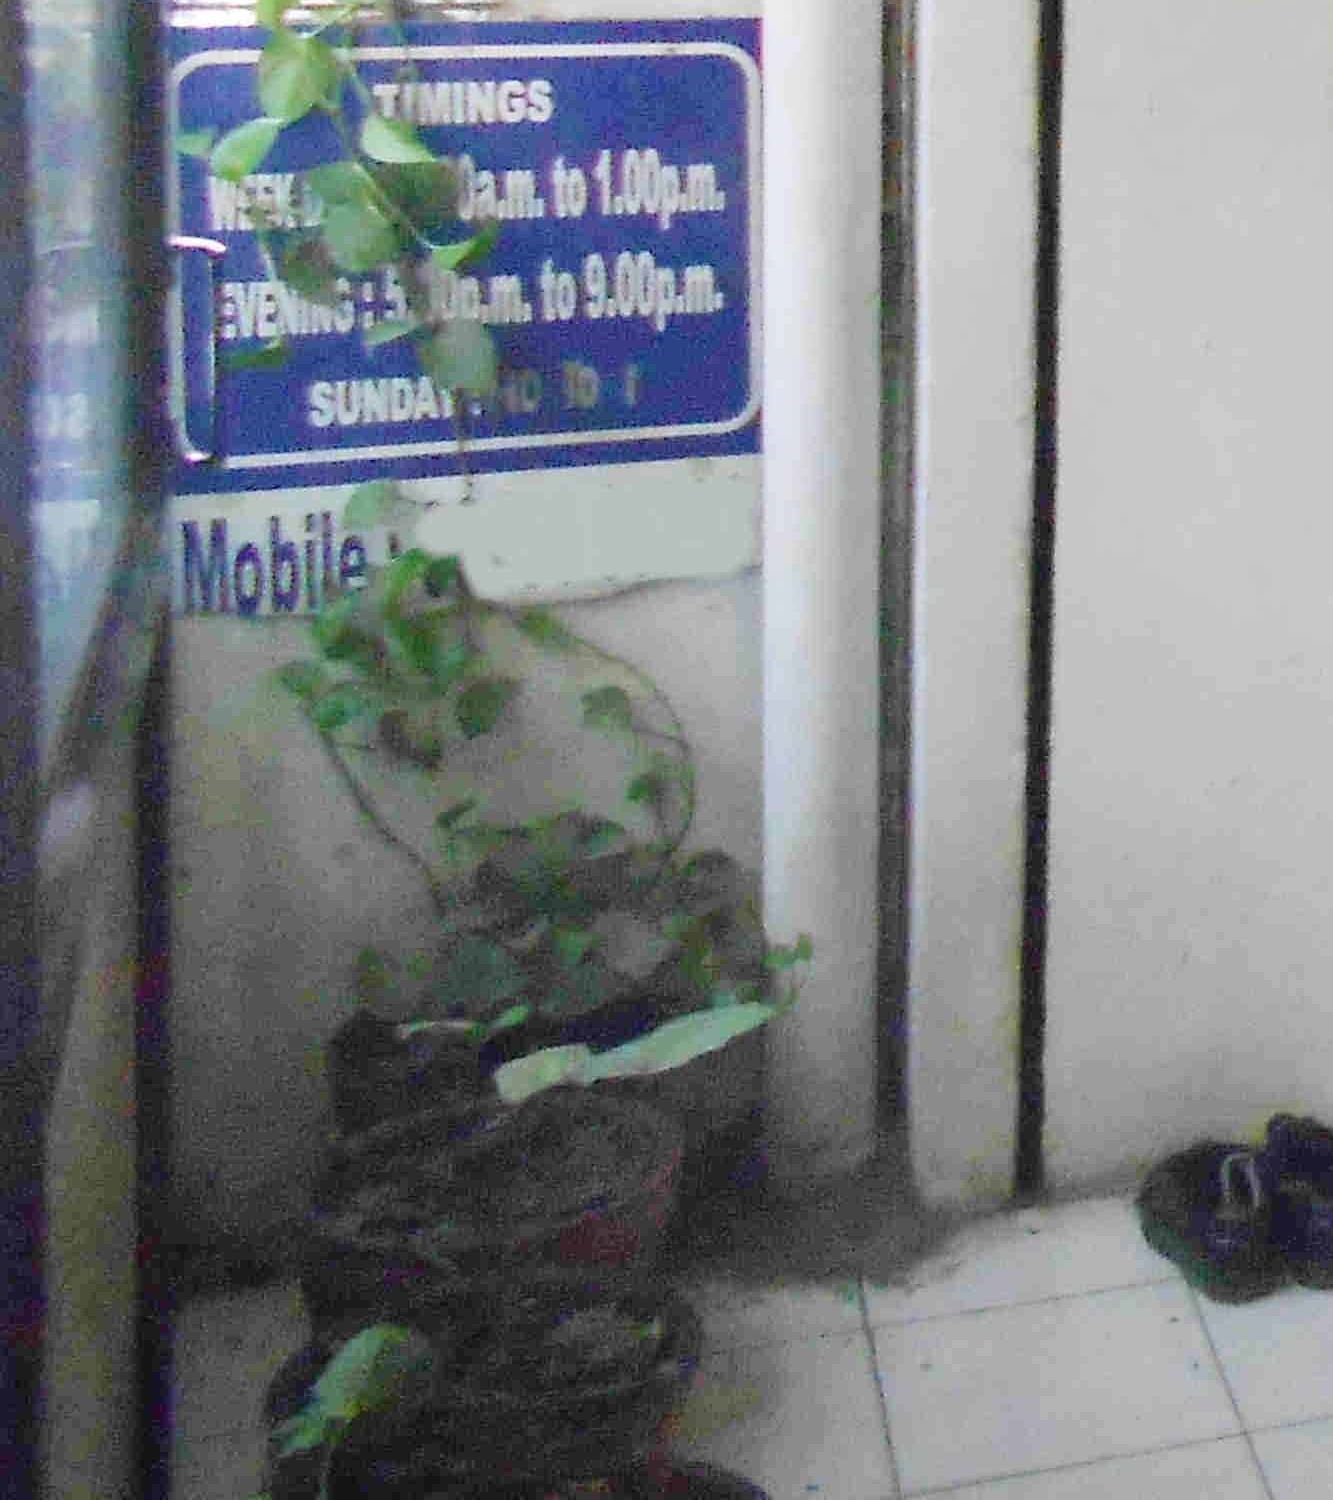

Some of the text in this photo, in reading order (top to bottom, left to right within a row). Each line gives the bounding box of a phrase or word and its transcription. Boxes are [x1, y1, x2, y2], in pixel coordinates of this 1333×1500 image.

[372, 79, 555, 125] TIMINGS
[553, 156, 587, 218] to
[597, 149, 727, 231] 1.00p.m.
[540, 258, 576, 321] to
[582, 251, 725, 332] 9.00p.m.
[179, 510, 367, 616] Mobile
